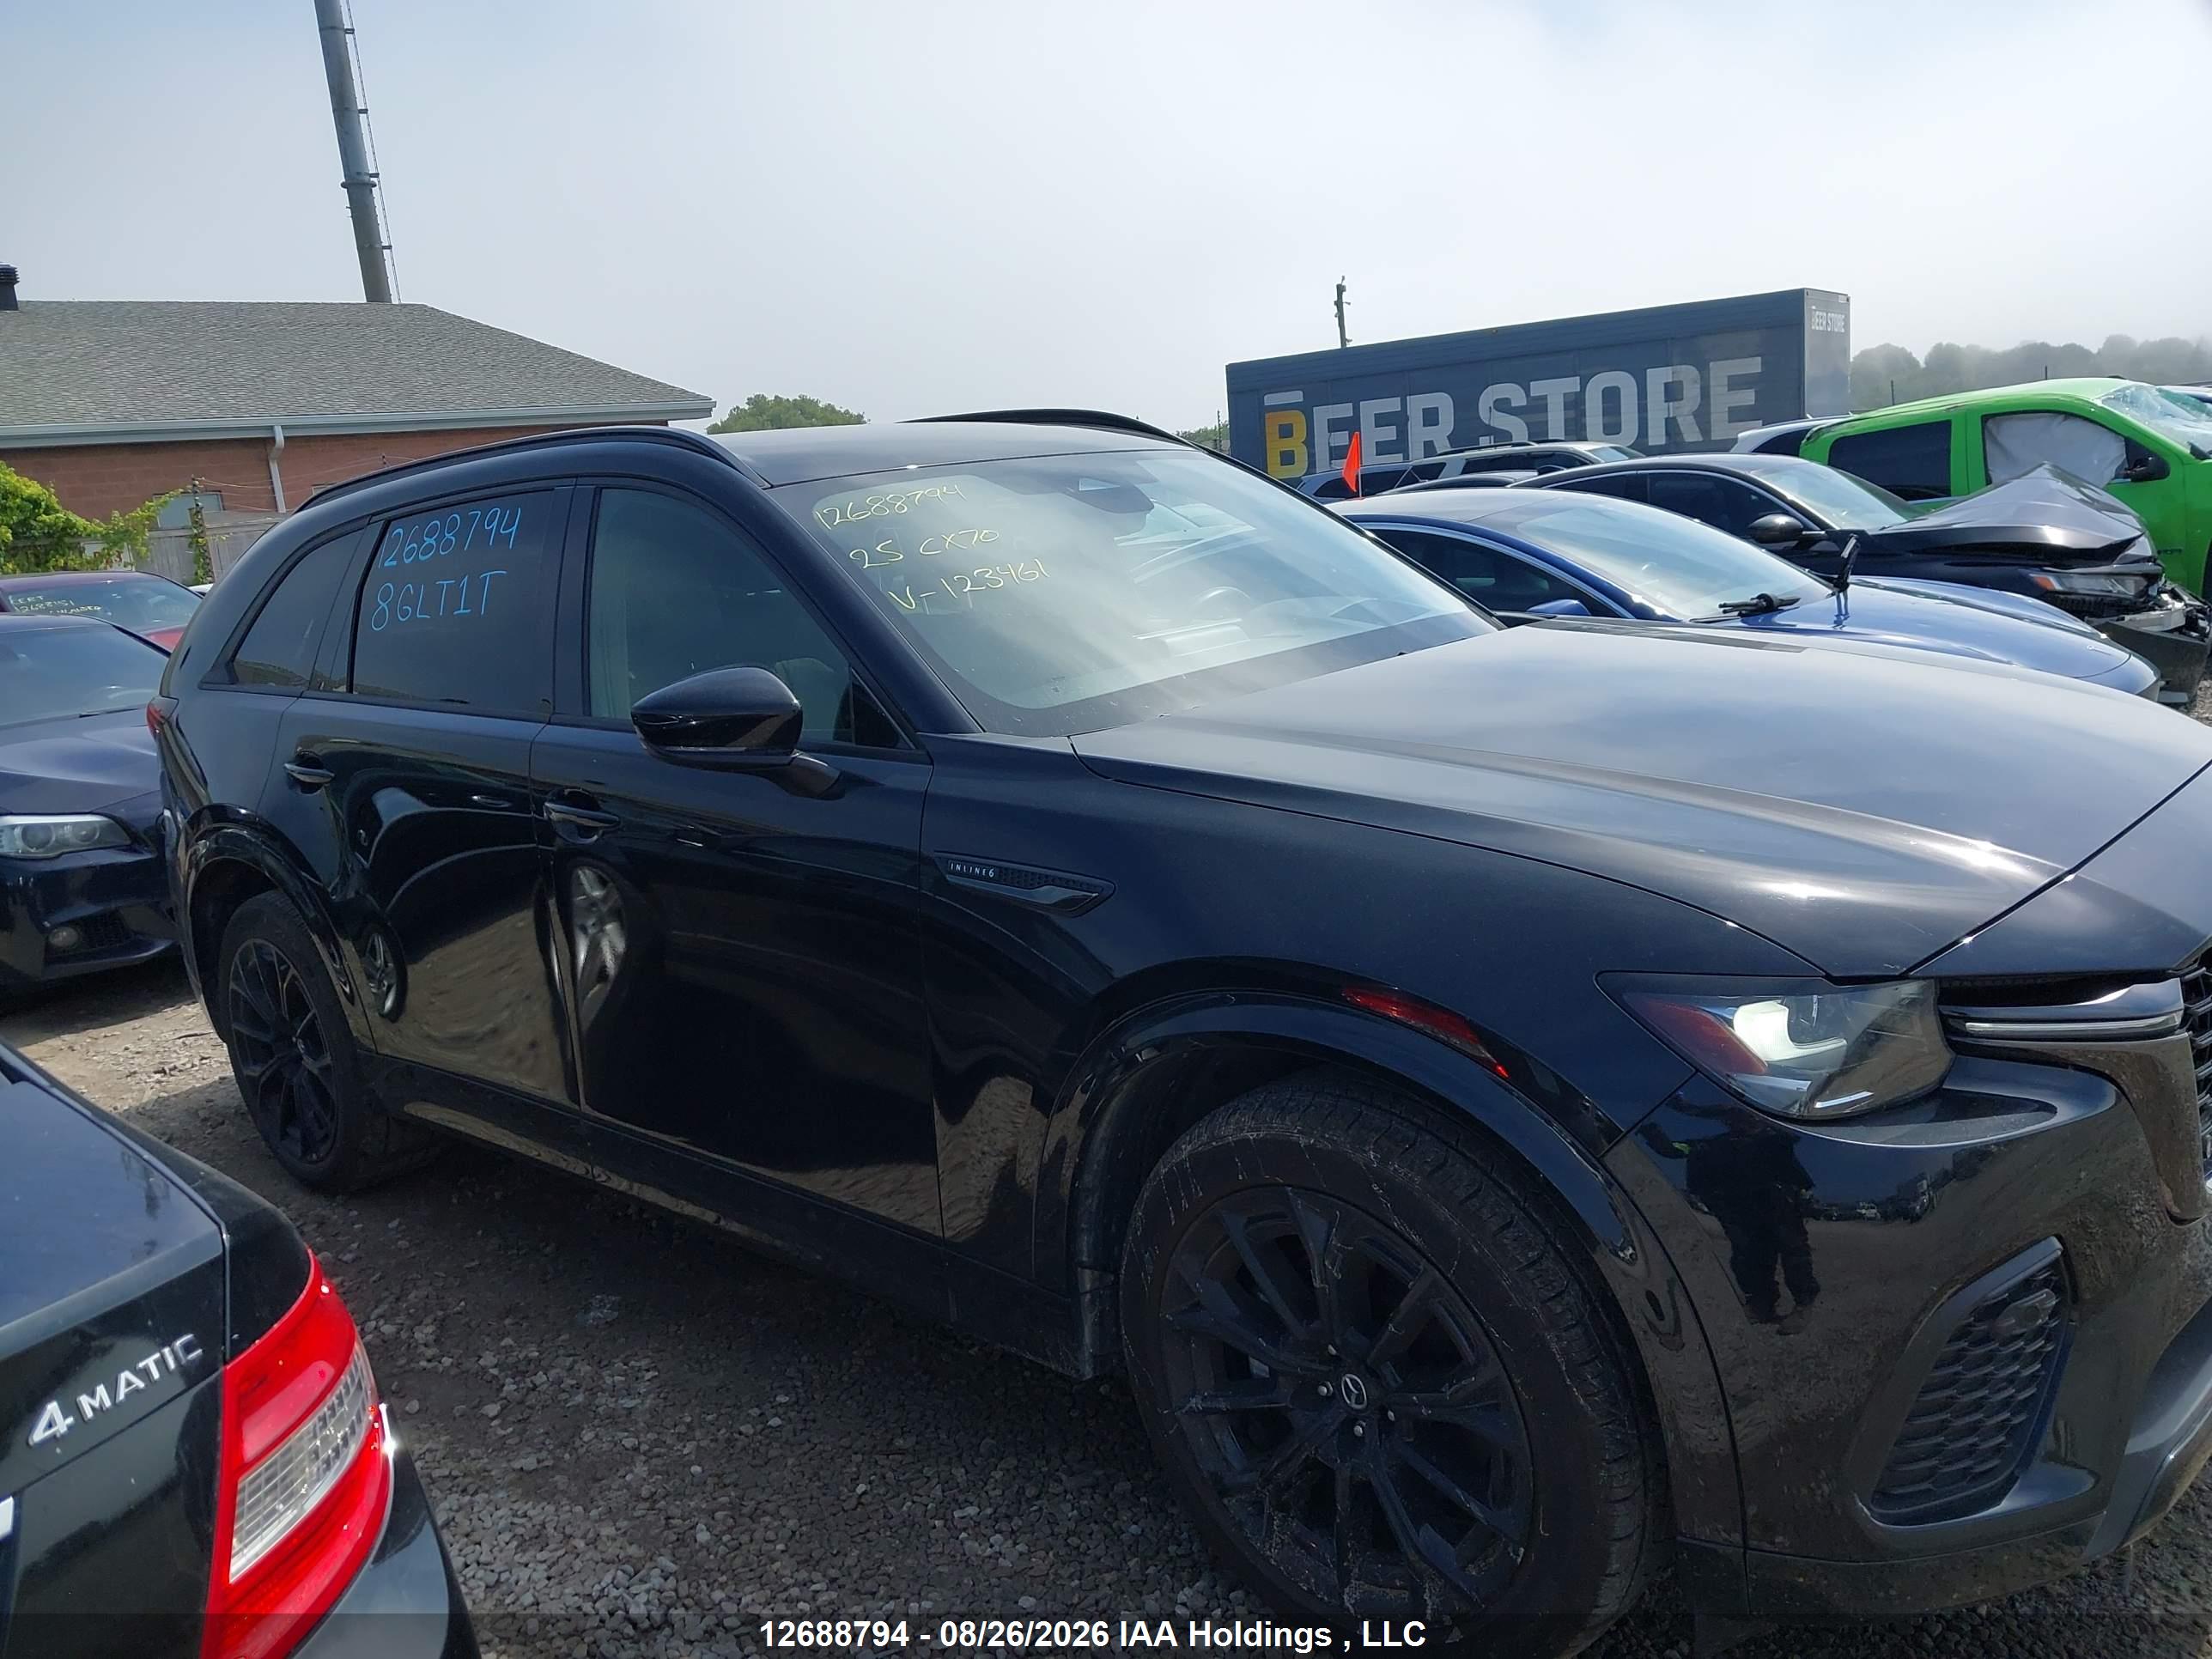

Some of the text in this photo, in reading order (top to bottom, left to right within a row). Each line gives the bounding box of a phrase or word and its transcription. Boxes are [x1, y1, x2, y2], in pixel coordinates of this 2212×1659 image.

[1264, 356, 1763, 479] BEER STORE
[815, 483, 967, 531] 12688794
[377, 507, 522, 569] 12688794
[919, 528, 1001, 556] CX70
